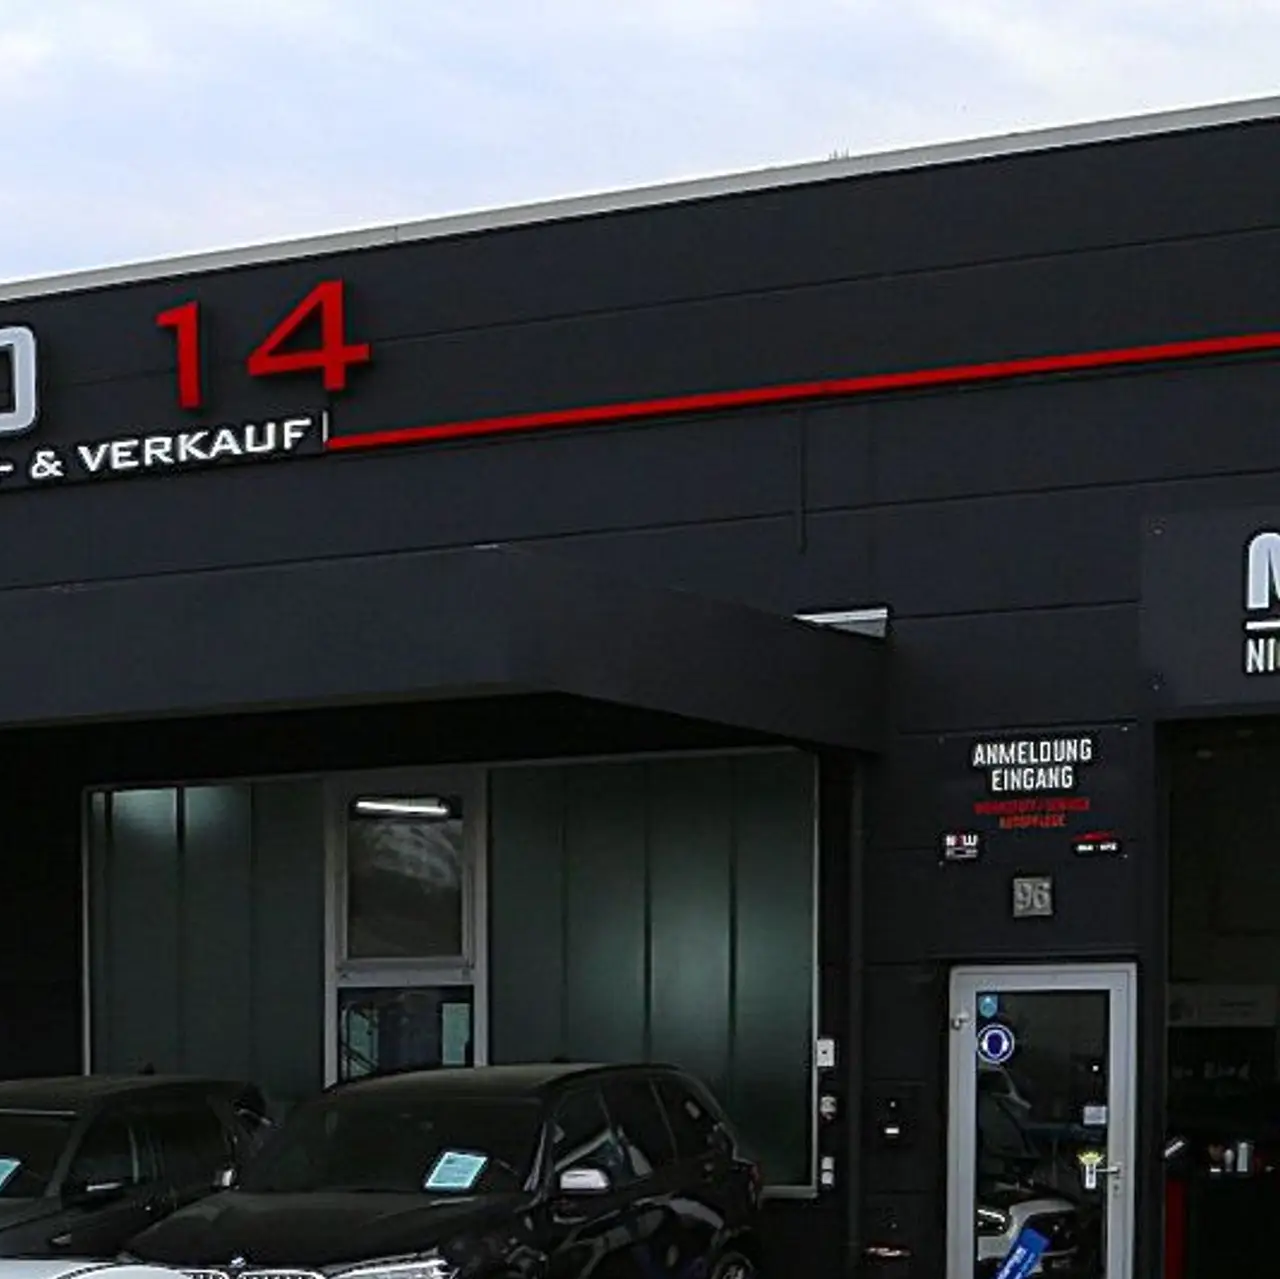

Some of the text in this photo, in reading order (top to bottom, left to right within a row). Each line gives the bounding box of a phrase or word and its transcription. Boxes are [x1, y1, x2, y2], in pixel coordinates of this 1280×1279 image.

[155, 279, 372, 409] 14
[30, 450, 64, 480] &
[78, 416, 316, 473] VERKAUF
[972, 738, 1092, 767] ANMELDUNG
[991, 766, 1074, 791] EINGANG
[1016, 881, 1052, 911] 96
